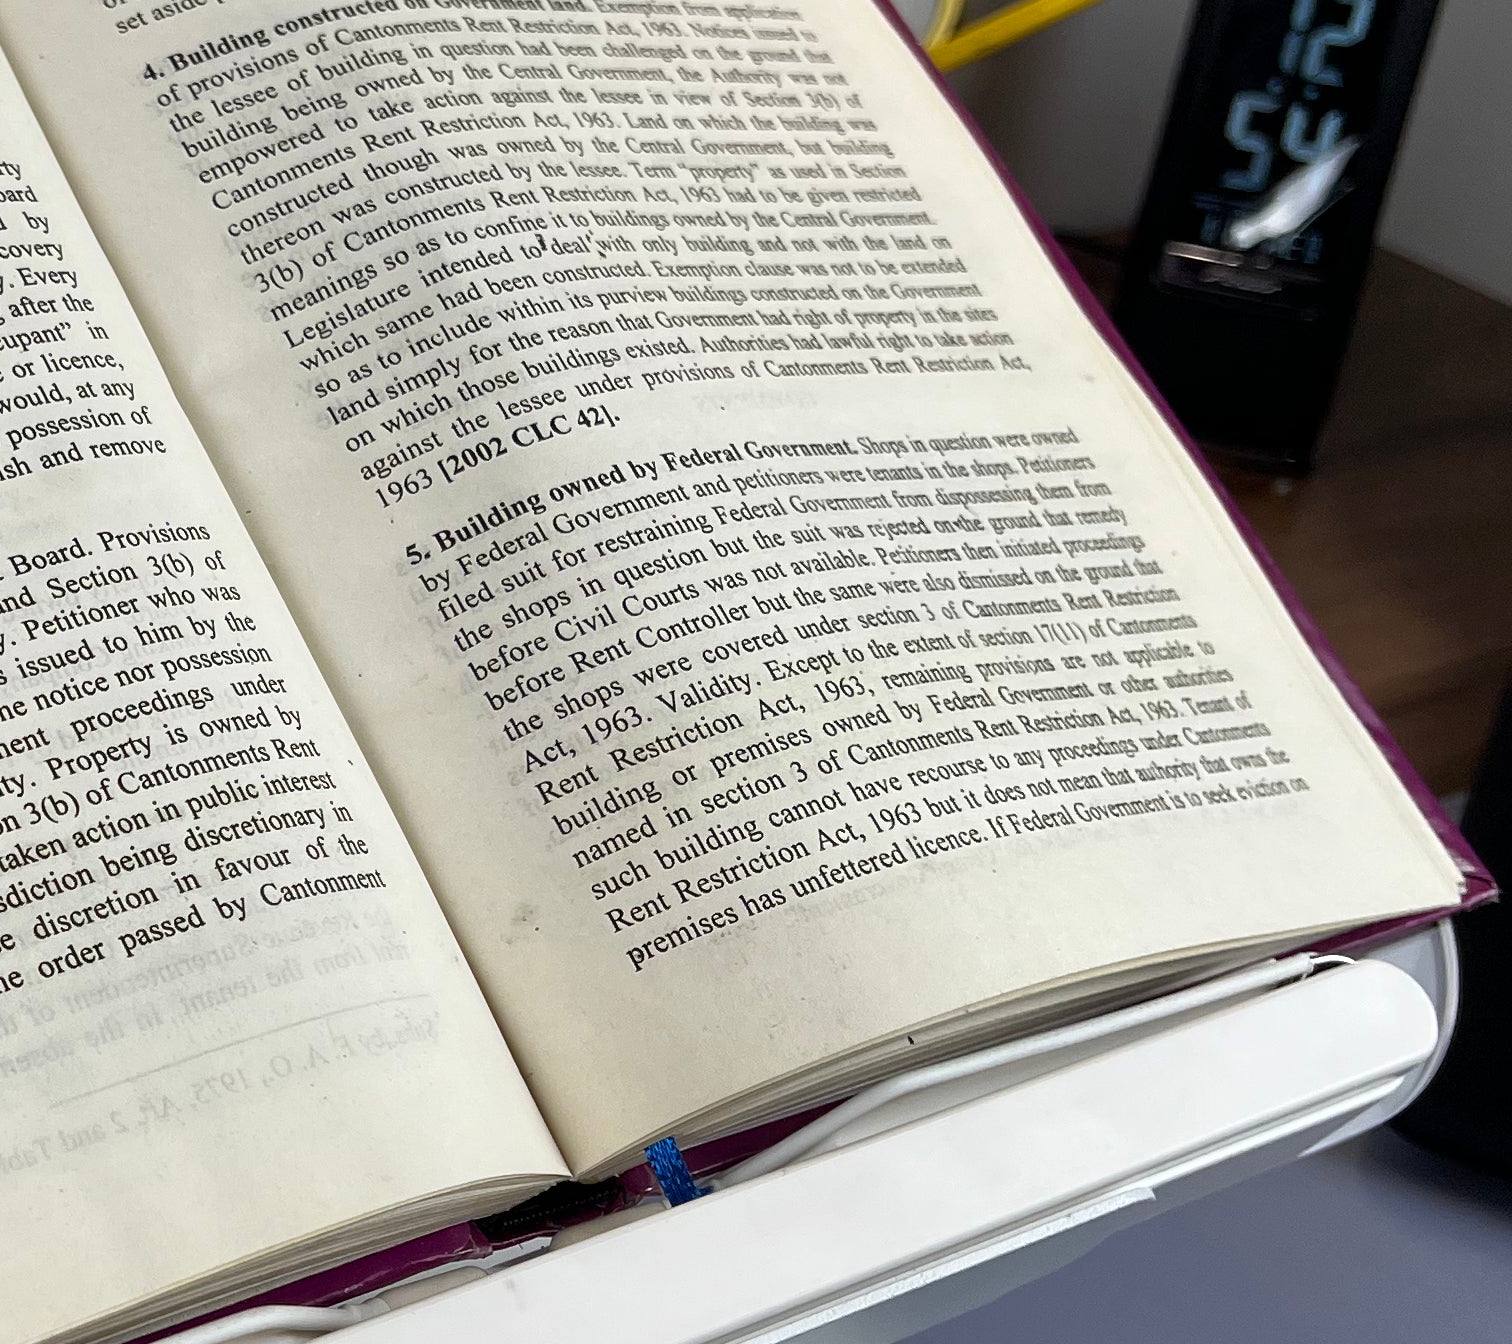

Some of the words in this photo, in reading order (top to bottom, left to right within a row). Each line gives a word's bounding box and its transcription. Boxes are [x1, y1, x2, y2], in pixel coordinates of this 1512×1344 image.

[116, 12, 148, 33] set
[144, 64, 164, 80] 4.
[167, 29, 270, 71] Building
[327, 388, 381, 424] land
[385, 357, 459, 399] simply
[469, 342, 502, 364] for
[508, 331, 543, 351] the
[547, 321, 614, 342] reason
[616, 313, 654, 330] that
[655, 311, 759, 328] Government
[755, 309, 792, 325] had
[792, 309, 832, 329] right
[833, 308, 852, 324] of
[853, 310, 917, 328] property
[376, 469, 432, 508] 1963
[437, 437, 507, 483] [2002
[511, 414, 571, 446] CLC
[578, 404, 620, 427] 42].
[406, 543, 430, 564] 5.
[432, 494, 546, 552] Building
[549, 464, 626, 501] owned
[627, 461, 657, 480] by
[659, 443, 743, 471] Federal
[857, 436, 909, 458] Shops
[906, 435, 928, 452] in
[929, 432, 992, 456] question
[6, 536, 93, 577] Board.
[95, 521, 211, 552] Provisions
[484, 667, 565, 710] before
[568, 638, 631, 674] Rent
[636, 604, 750, 648] Controller
[751, 593, 792, 614] but
[793, 586, 825, 606] the
[829, 583, 876, 601] same
[877, 572, 920, 593] were
[922, 572, 955, 591] also
[958, 567, 1033, 589] dismissed
[1034, 570, 1056, 584] on
[37, 941, 106, 979] order
[117, 903, 207, 958] passed
[211, 896, 246, 922] by
[259, 869, 387, 906] Cantonment
[626, 907, 738, 972] premises
[738, 888, 786, 916] has
[789, 842, 908, 897] unfettered
[905, 829, 988, 858] licence.
[985, 815, 1009, 838] If
[1006, 804, 1076, 834] Federal
[1073, 795, 1171, 822] Government
[1165, 790, 1186, 809] is
[1183, 791, 1202, 806] to
